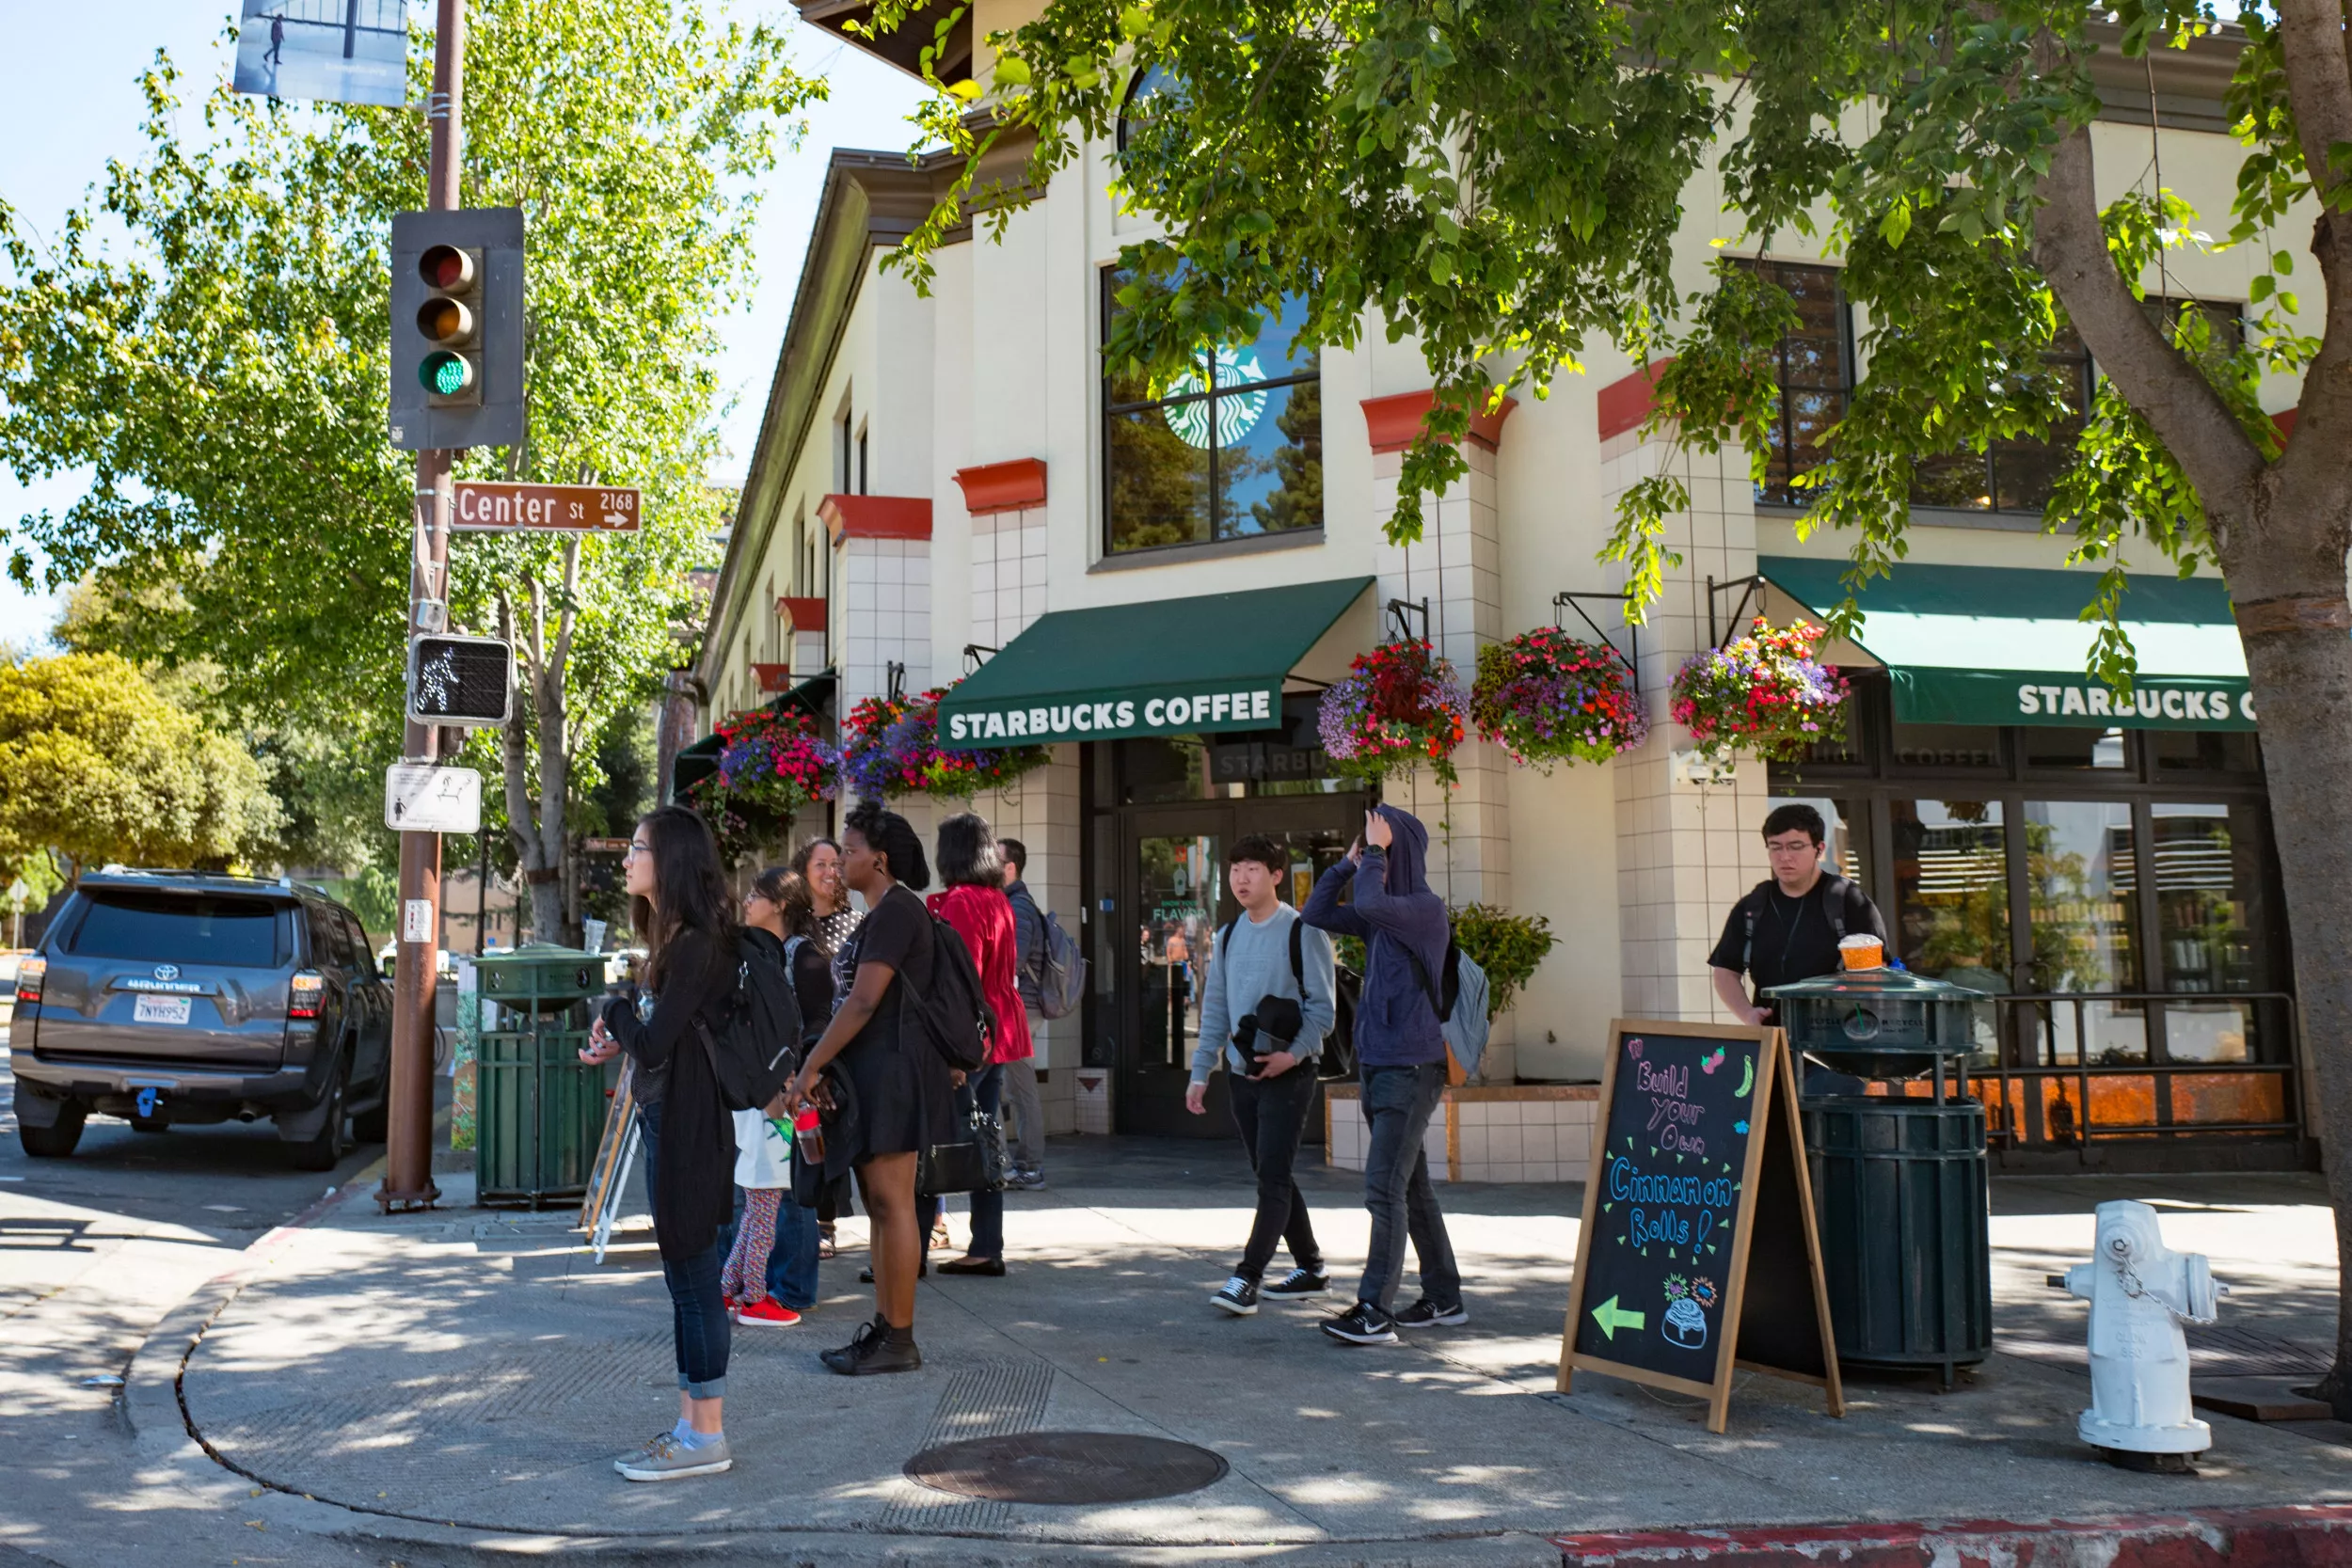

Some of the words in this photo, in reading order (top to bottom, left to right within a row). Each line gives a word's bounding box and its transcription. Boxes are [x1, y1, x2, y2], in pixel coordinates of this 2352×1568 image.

[459, 488, 556, 524] Center
[569, 501, 584, 520] St
[599, 492, 633, 511] 2168
[949, 701, 1135, 739] STARBUCKS
[1144, 690, 1270, 727] COFFEE
[1637, 1061, 1689, 1099] Build
[1661, 1123, 1705, 1155] Own
[1610, 1156, 1732, 1208] Cinnamon
